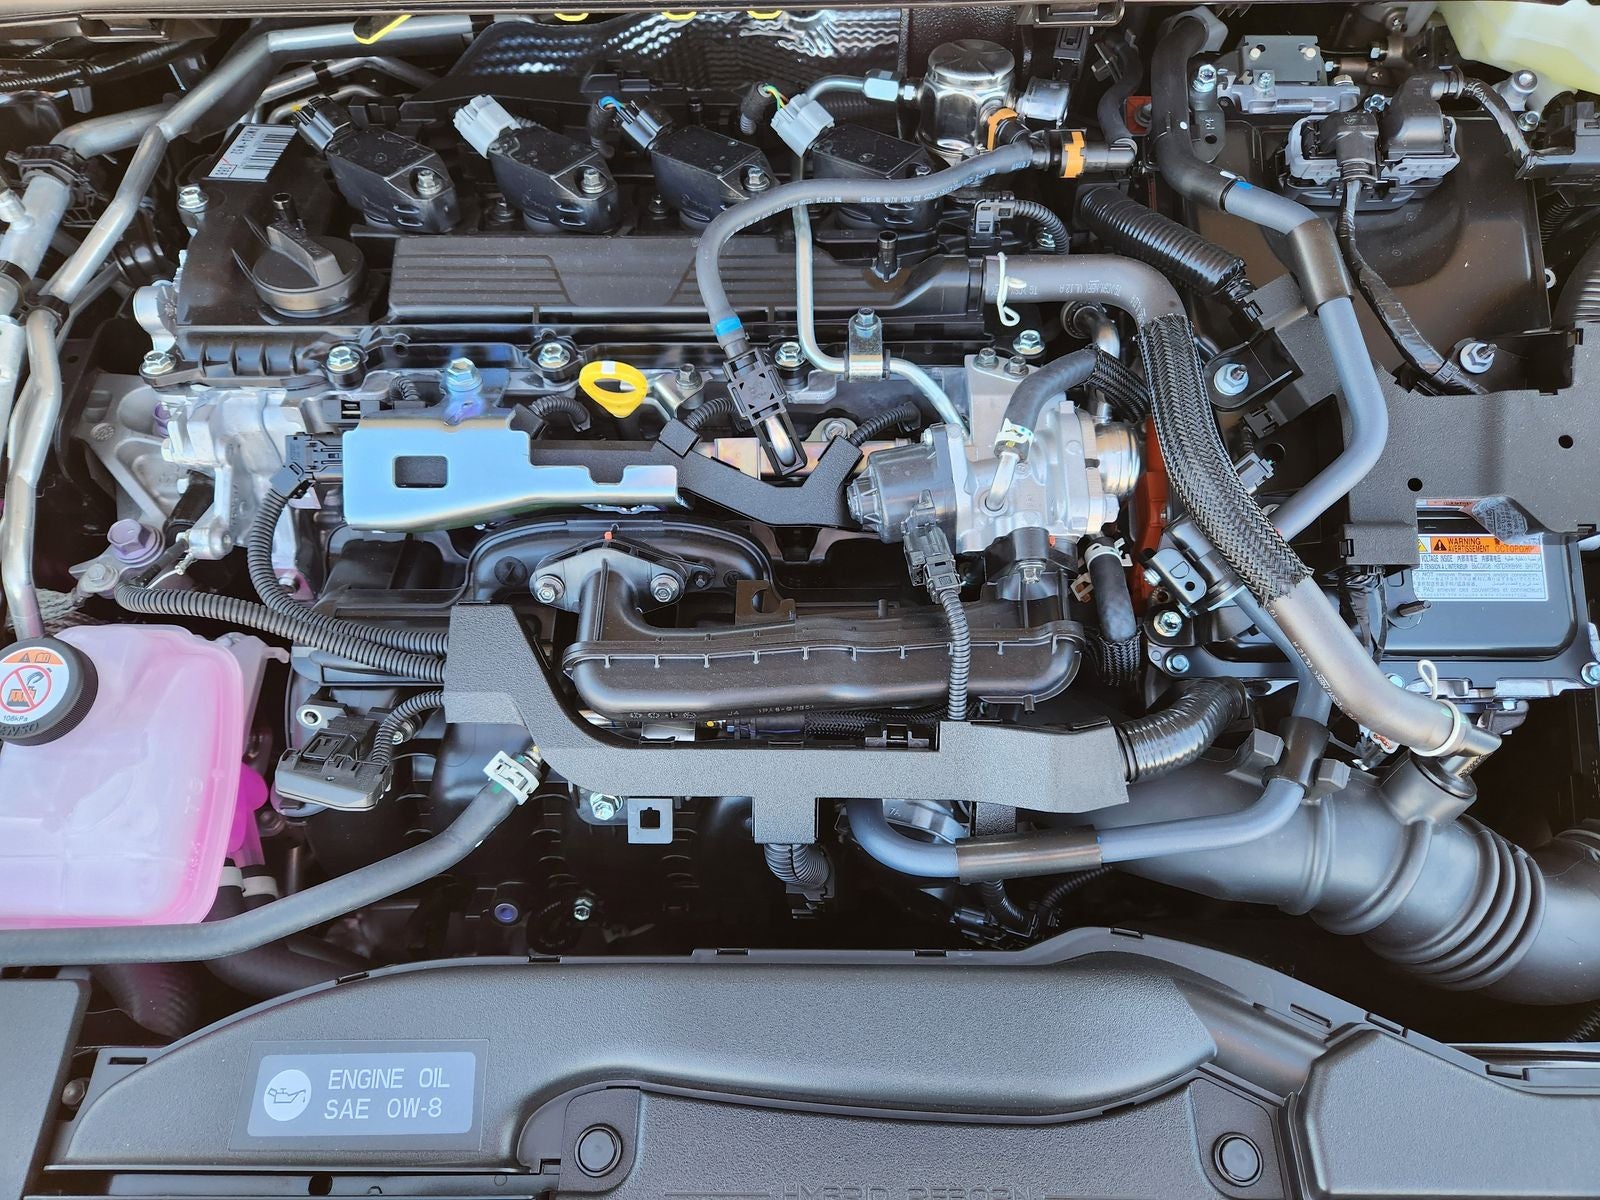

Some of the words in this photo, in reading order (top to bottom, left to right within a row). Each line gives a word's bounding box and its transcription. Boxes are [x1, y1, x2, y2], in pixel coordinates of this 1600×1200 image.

[1448, 537, 1481, 546] WARNING
[1448, 545, 1490, 553] AVERTISSEMENT
[327, 1067, 405, 1090] ENGINE
[418, 1067, 450, 1088] OIL
[323, 1097, 371, 1120] SAE
